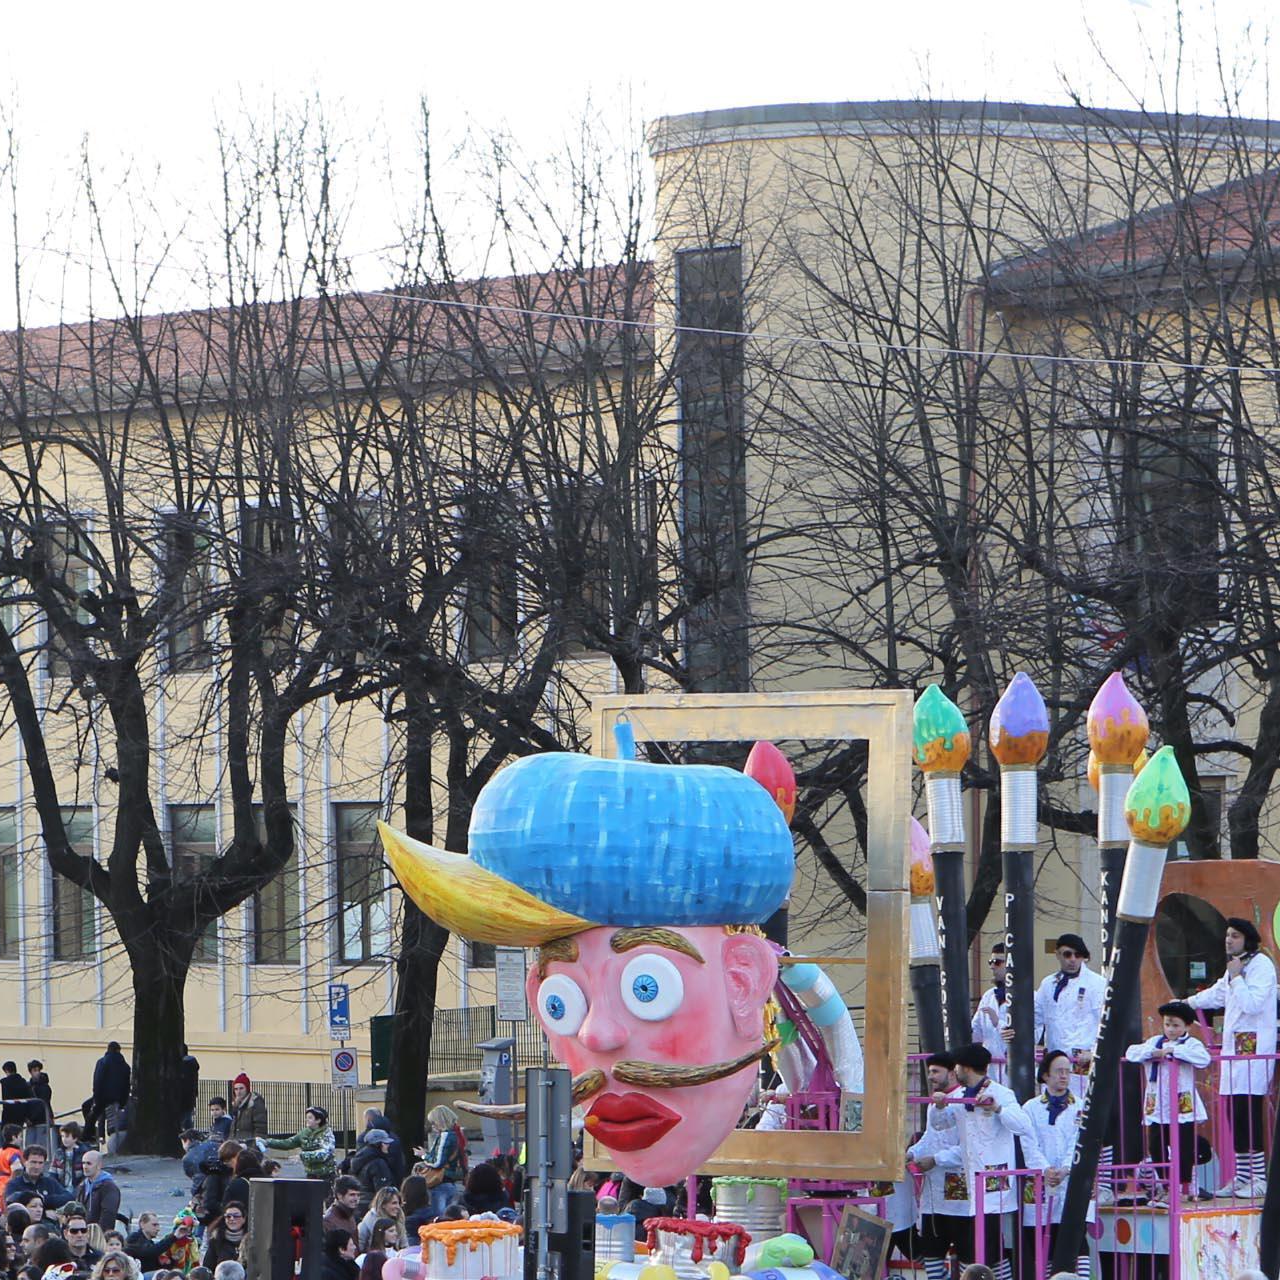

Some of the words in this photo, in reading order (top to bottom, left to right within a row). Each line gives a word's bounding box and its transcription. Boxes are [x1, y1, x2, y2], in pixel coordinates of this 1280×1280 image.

[936, 896, 946, 949] VAN
[1004, 893, 1015, 1028] PICASSO
[331, 986, 346, 1010] P
